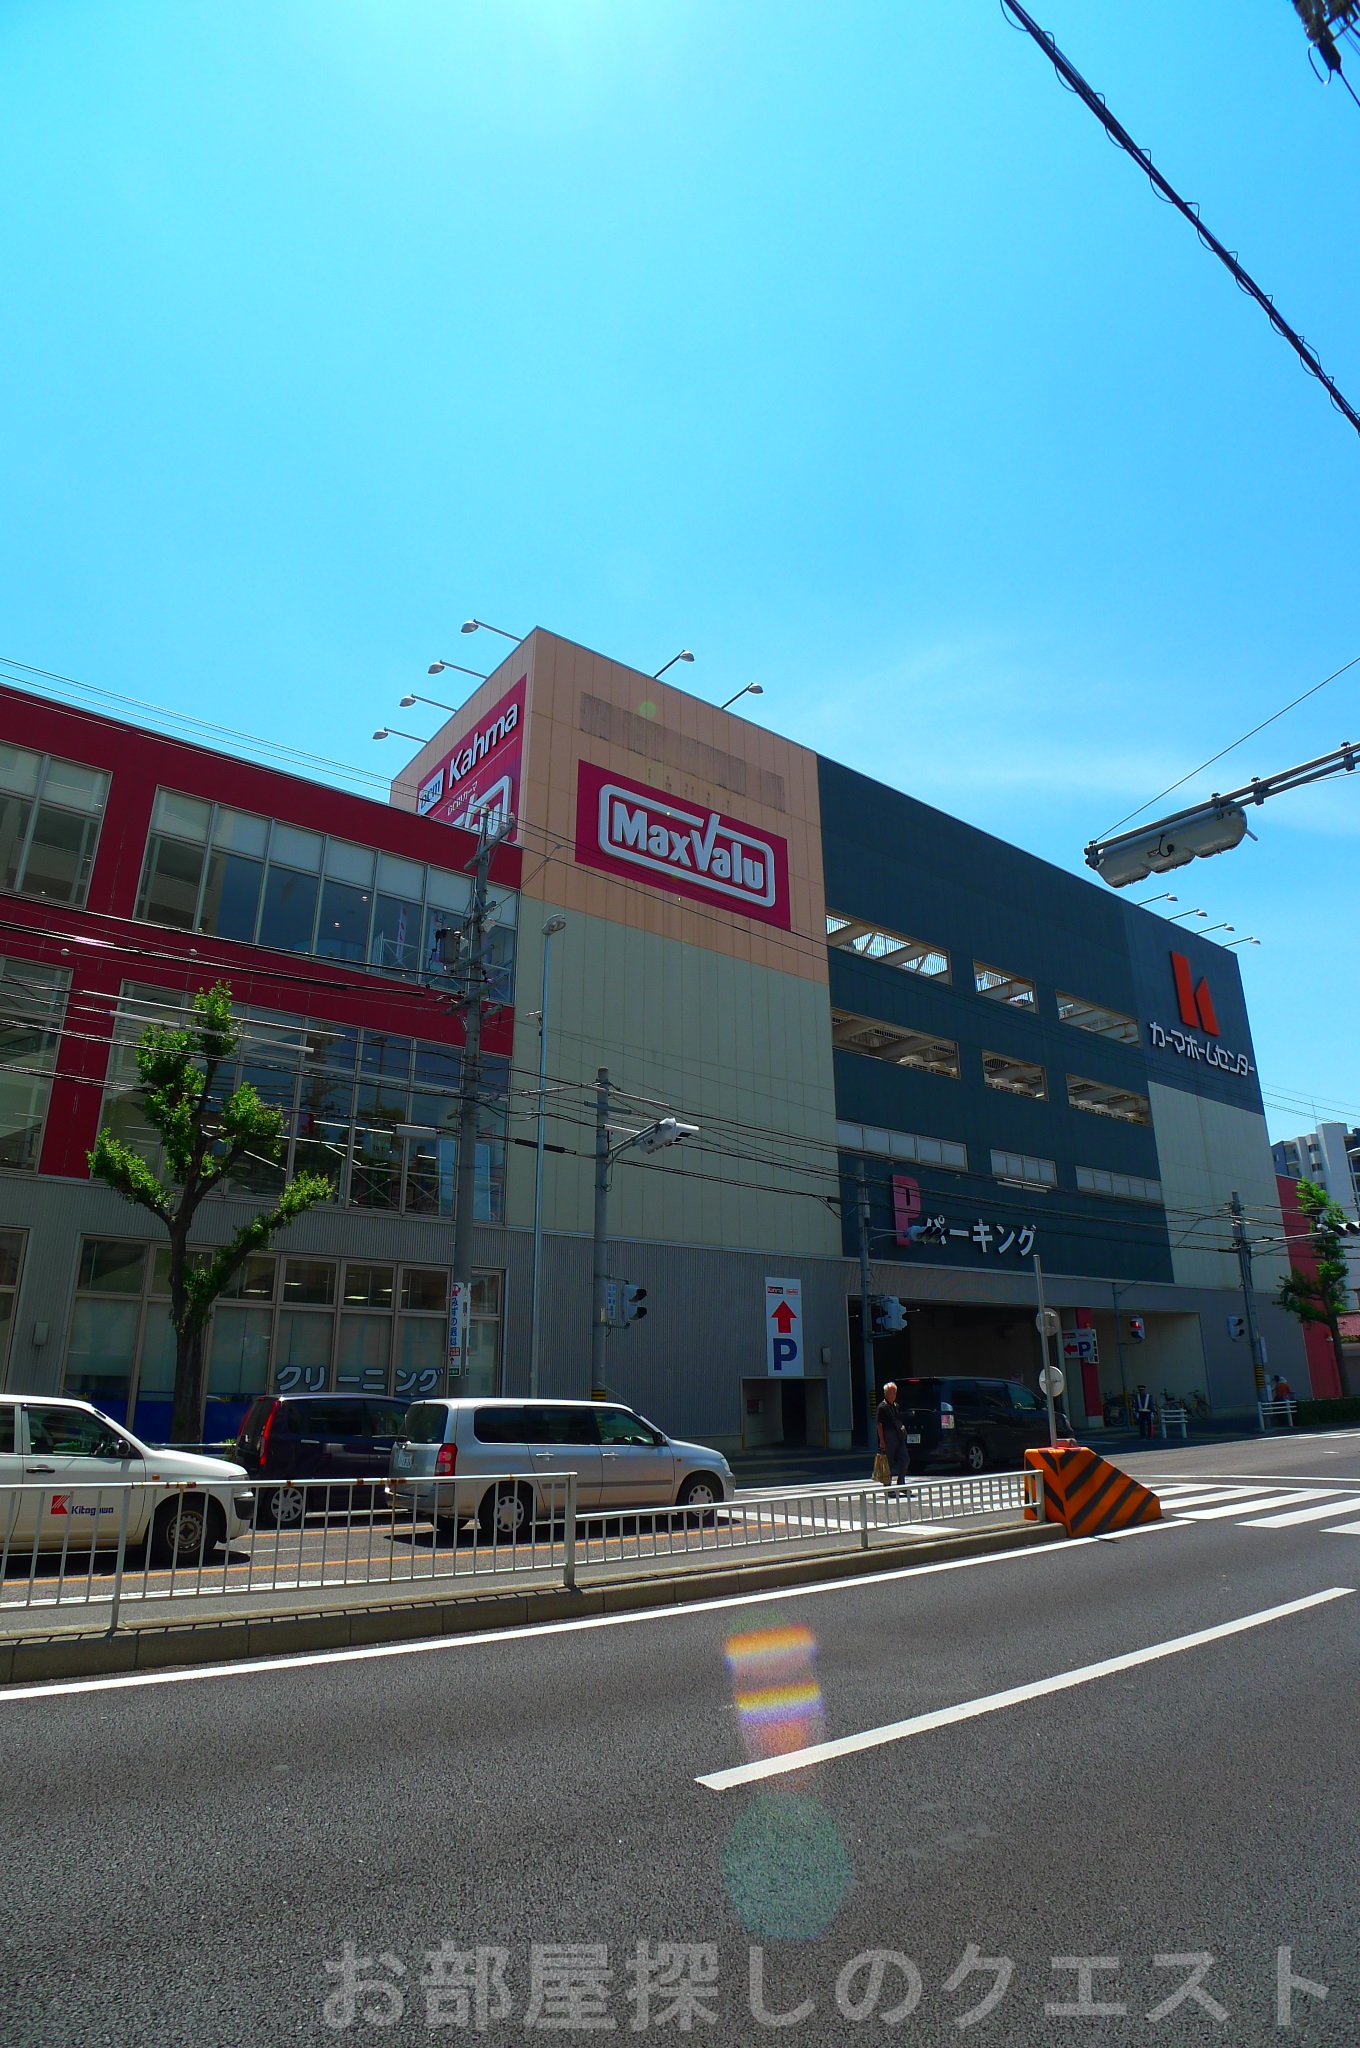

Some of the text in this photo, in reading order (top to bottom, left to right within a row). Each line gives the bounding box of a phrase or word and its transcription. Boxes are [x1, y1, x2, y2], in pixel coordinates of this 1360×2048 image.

[448, 703, 518, 789] Kahma
[612, 801, 764, 890] MaxValu
[1150, 1022, 1255, 1076] カーマホームセンター
[893, 1174, 921, 1246] P
[773, 1338, 798, 1371] P
[1078, 1341, 1091, 1356] P
[277, 1366, 443, 1392] クリーニング
